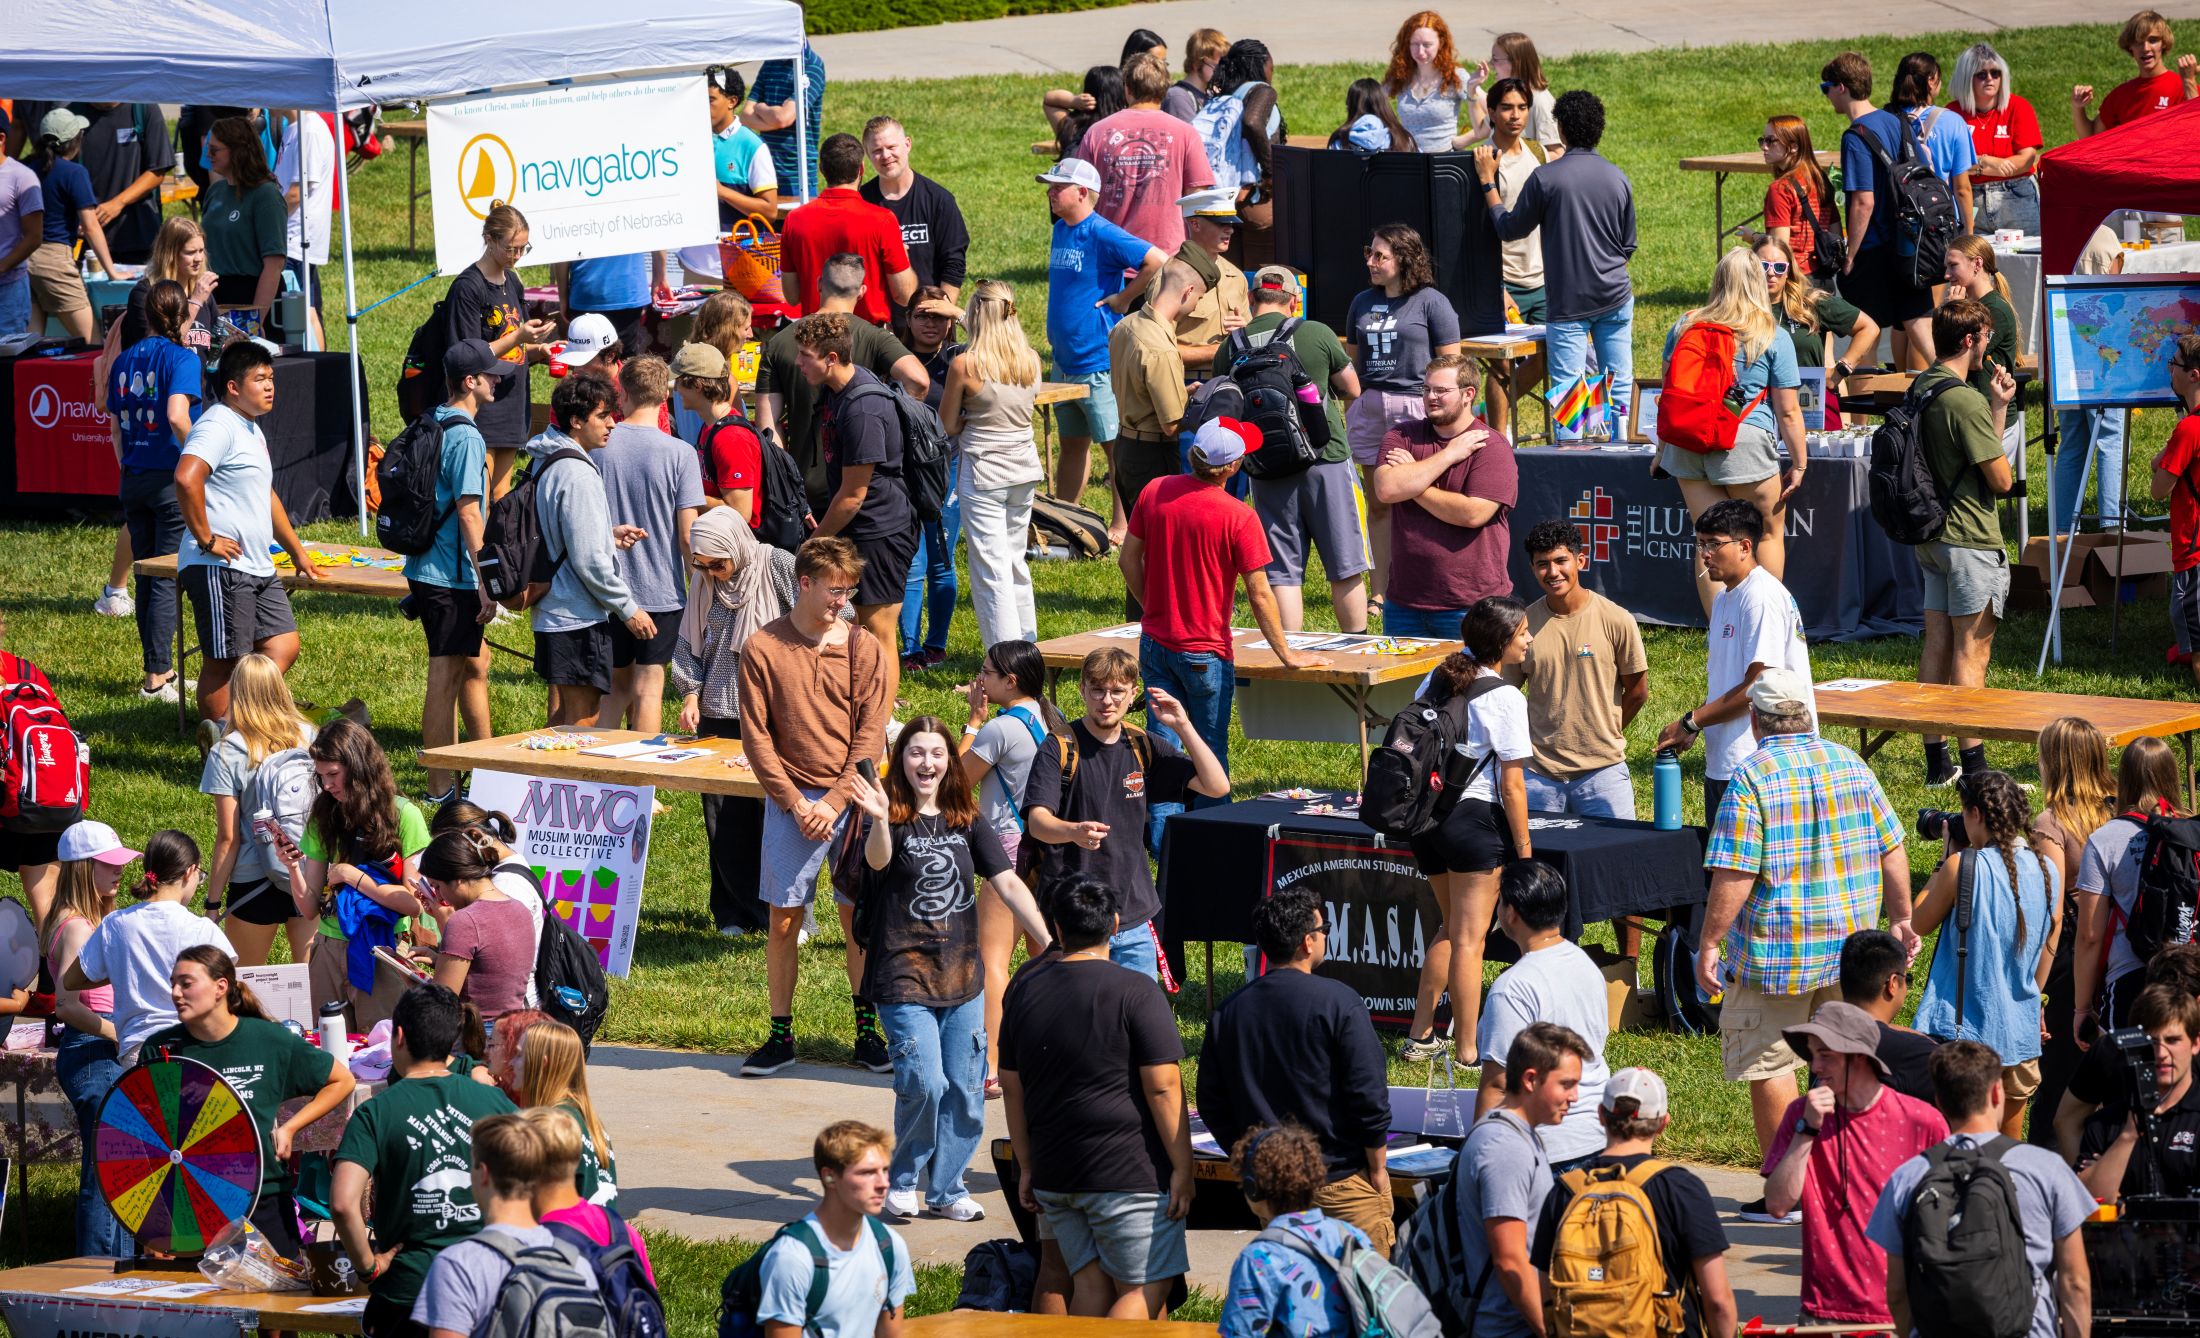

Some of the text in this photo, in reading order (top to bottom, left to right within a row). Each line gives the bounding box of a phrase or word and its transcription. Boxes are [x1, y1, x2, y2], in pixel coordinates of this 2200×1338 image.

[454, 106, 463, 116] To
[464, 105, 482, 115] know
[510, 101, 530, 110] make
[532, 97, 548, 107] Him
[576, 92, 590, 102] and
[592, 90, 608, 103] help
[609, 88, 632, 99] others
[633, 86, 643, 96] do
[644, 84, 656, 94] the
[522, 143, 679, 197] navigators
[543, 210, 683, 240] University of Nebraska
[902, 230, 926, 240] ECT
[63, 401, 112, 424] navig
[1627, 505, 1641, 554] THE
[1647, 540, 1696, 560] CENT
[513, 780, 638, 835] MWC
[528, 829, 626, 848] MUSLIM WOMEN'S
[532, 843, 612, 860] COLLECTIVE
[1276, 862, 1322, 890] MEXICAN
[1323, 858, 1371, 872] AMERICAN
[1373, 860, 1414, 877] STUDENT
[1361, 996, 1395, 1011] OWN
[1396, 998, 1417, 1011] SIN
[407, 1115, 429, 1136] MATH
[446, 1103, 473, 1127] PHYSICS
[424, 1114, 456, 1146] DYNAMICS
[426, 1154, 468, 1174] COOL CLOUDS
